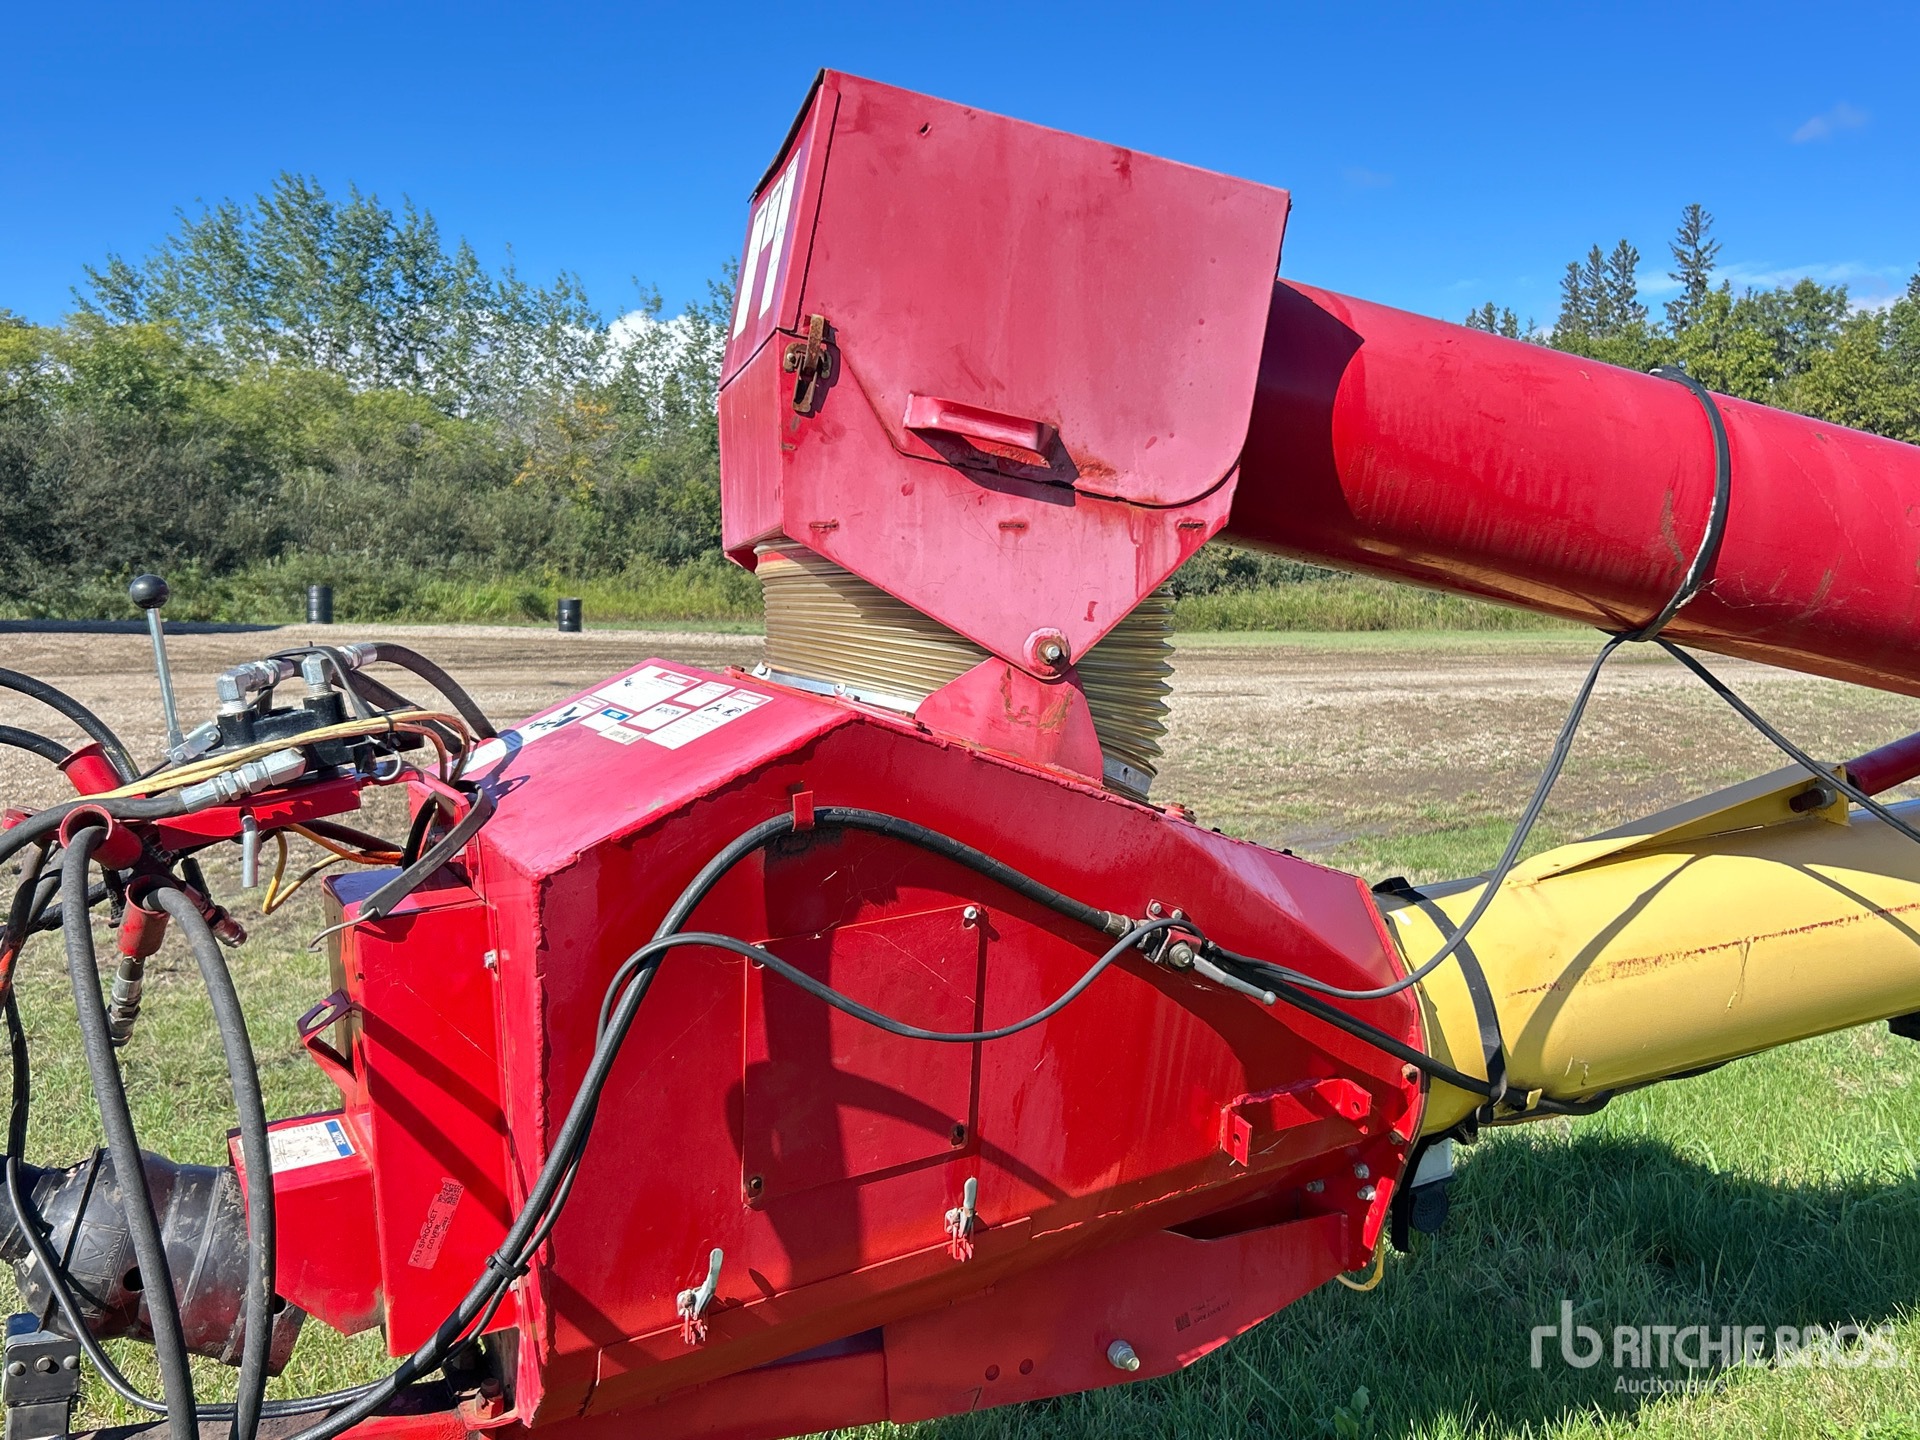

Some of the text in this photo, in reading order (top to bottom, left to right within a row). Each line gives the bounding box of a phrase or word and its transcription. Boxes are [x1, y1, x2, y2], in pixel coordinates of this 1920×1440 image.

[418, 1208, 438, 1249] SPROCKET
[426, 1223, 441, 1250] COVER
[103, 1235, 121, 1275] DANGER
